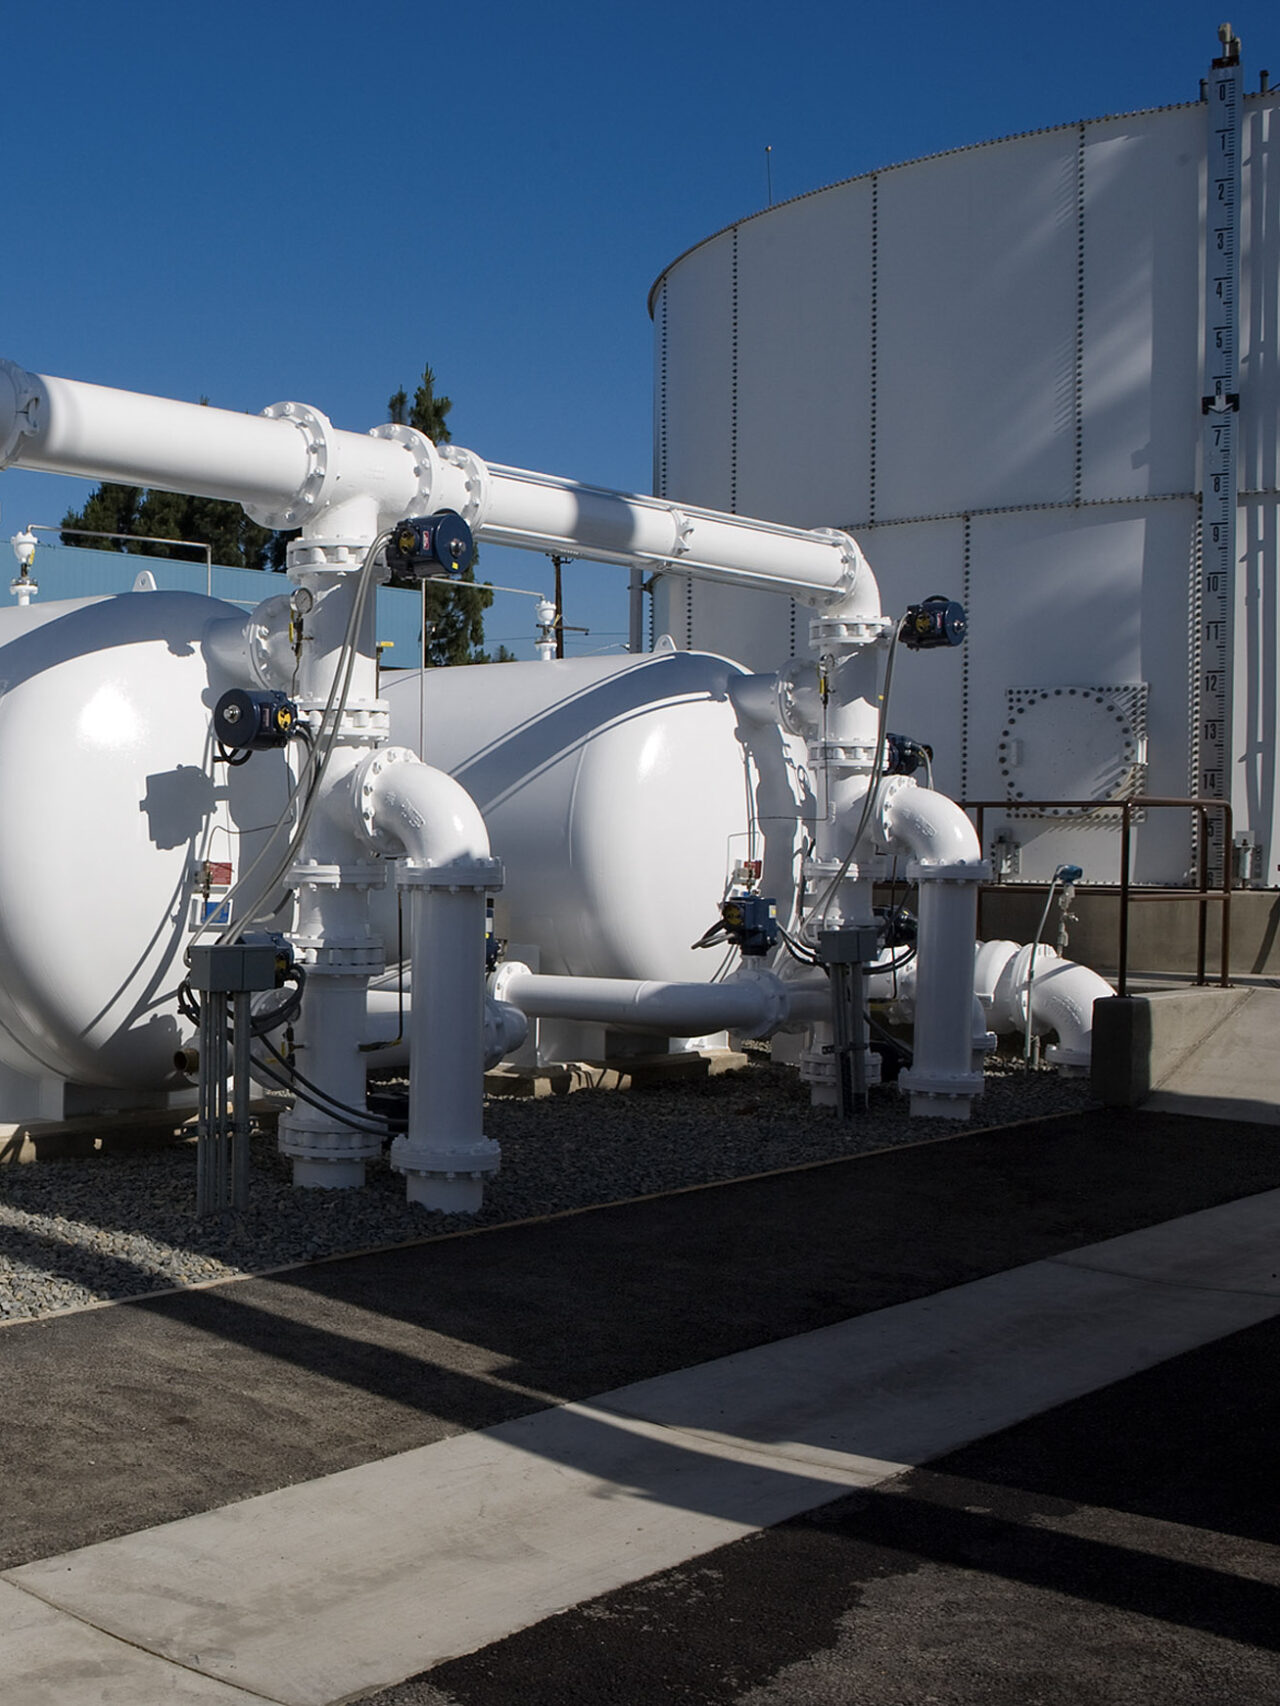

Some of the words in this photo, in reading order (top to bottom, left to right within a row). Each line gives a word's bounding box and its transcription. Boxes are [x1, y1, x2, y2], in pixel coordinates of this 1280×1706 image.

[1219, 84, 1226, 101] 0
[1221, 133, 1226, 151] 1
[1218, 183, 1225, 201] 2
[1217, 232, 1224, 250] 3
[1216, 281, 1223, 299] 4
[1216, 330, 1223, 348] 5
[1214, 429, 1221, 446] 7
[1213, 475, 1220, 493] 8
[1212, 525, 1220, 542] 9
[1206, 574, 1219, 592] 10
[1205, 623, 1219, 641] 11
[1204, 674, 1217, 692] 12
[1203, 723, 1217, 740] 13
[1203, 772, 1215, 790] 14
